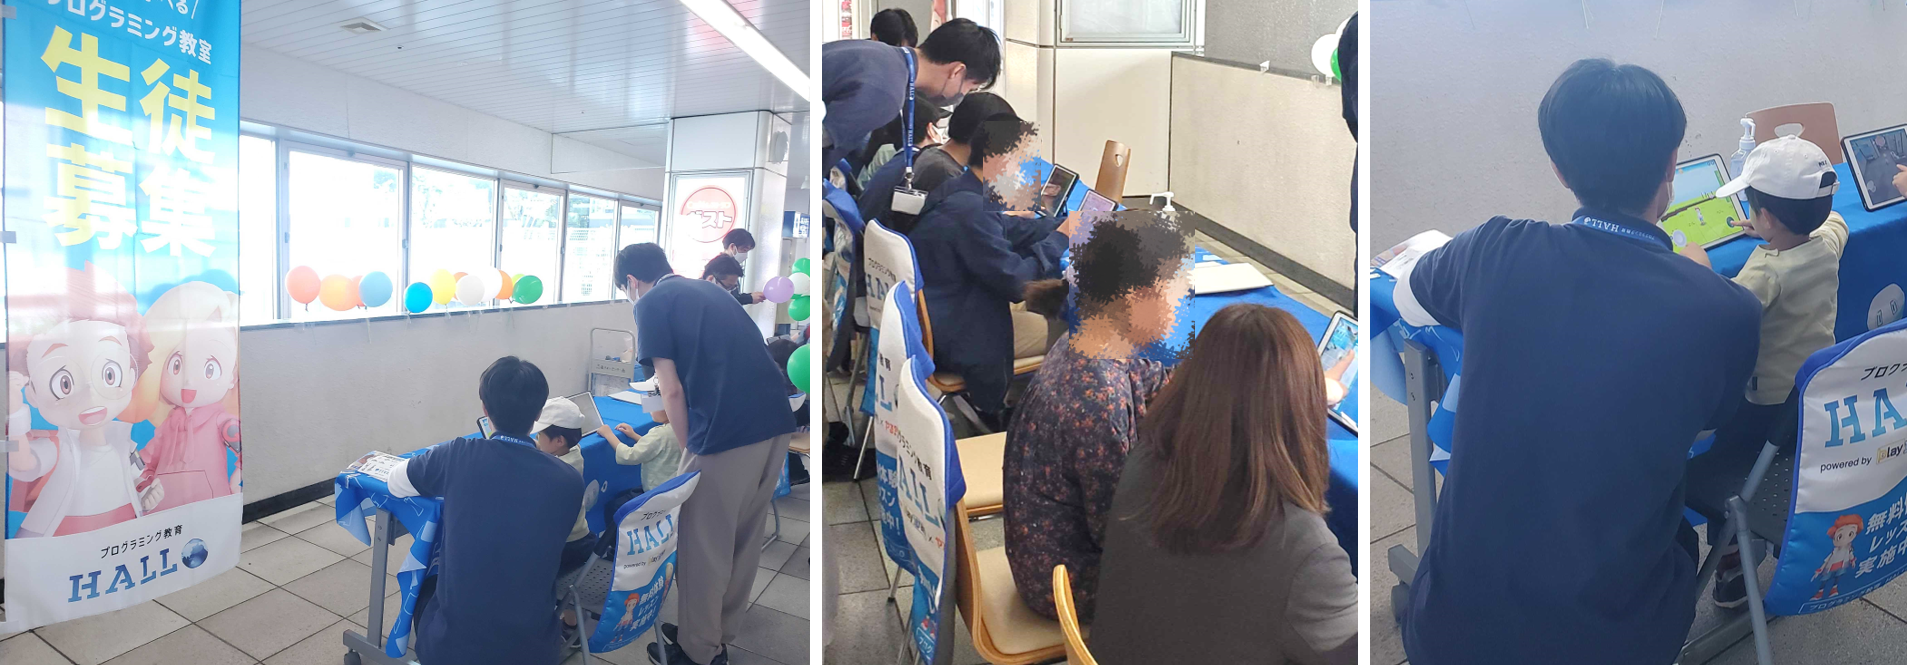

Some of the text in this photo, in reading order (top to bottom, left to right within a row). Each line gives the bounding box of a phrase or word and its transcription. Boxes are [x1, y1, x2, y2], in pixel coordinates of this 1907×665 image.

[47, 0, 212, 65] ログラミング教室
[41, 25, 215, 165] 生徒
[41, 142, 217, 258] 募集
[1820, 457, 1860, 473] powered
[1861, 456, 1872, 465] by
[101, 524, 183, 559] プログラミング教育
